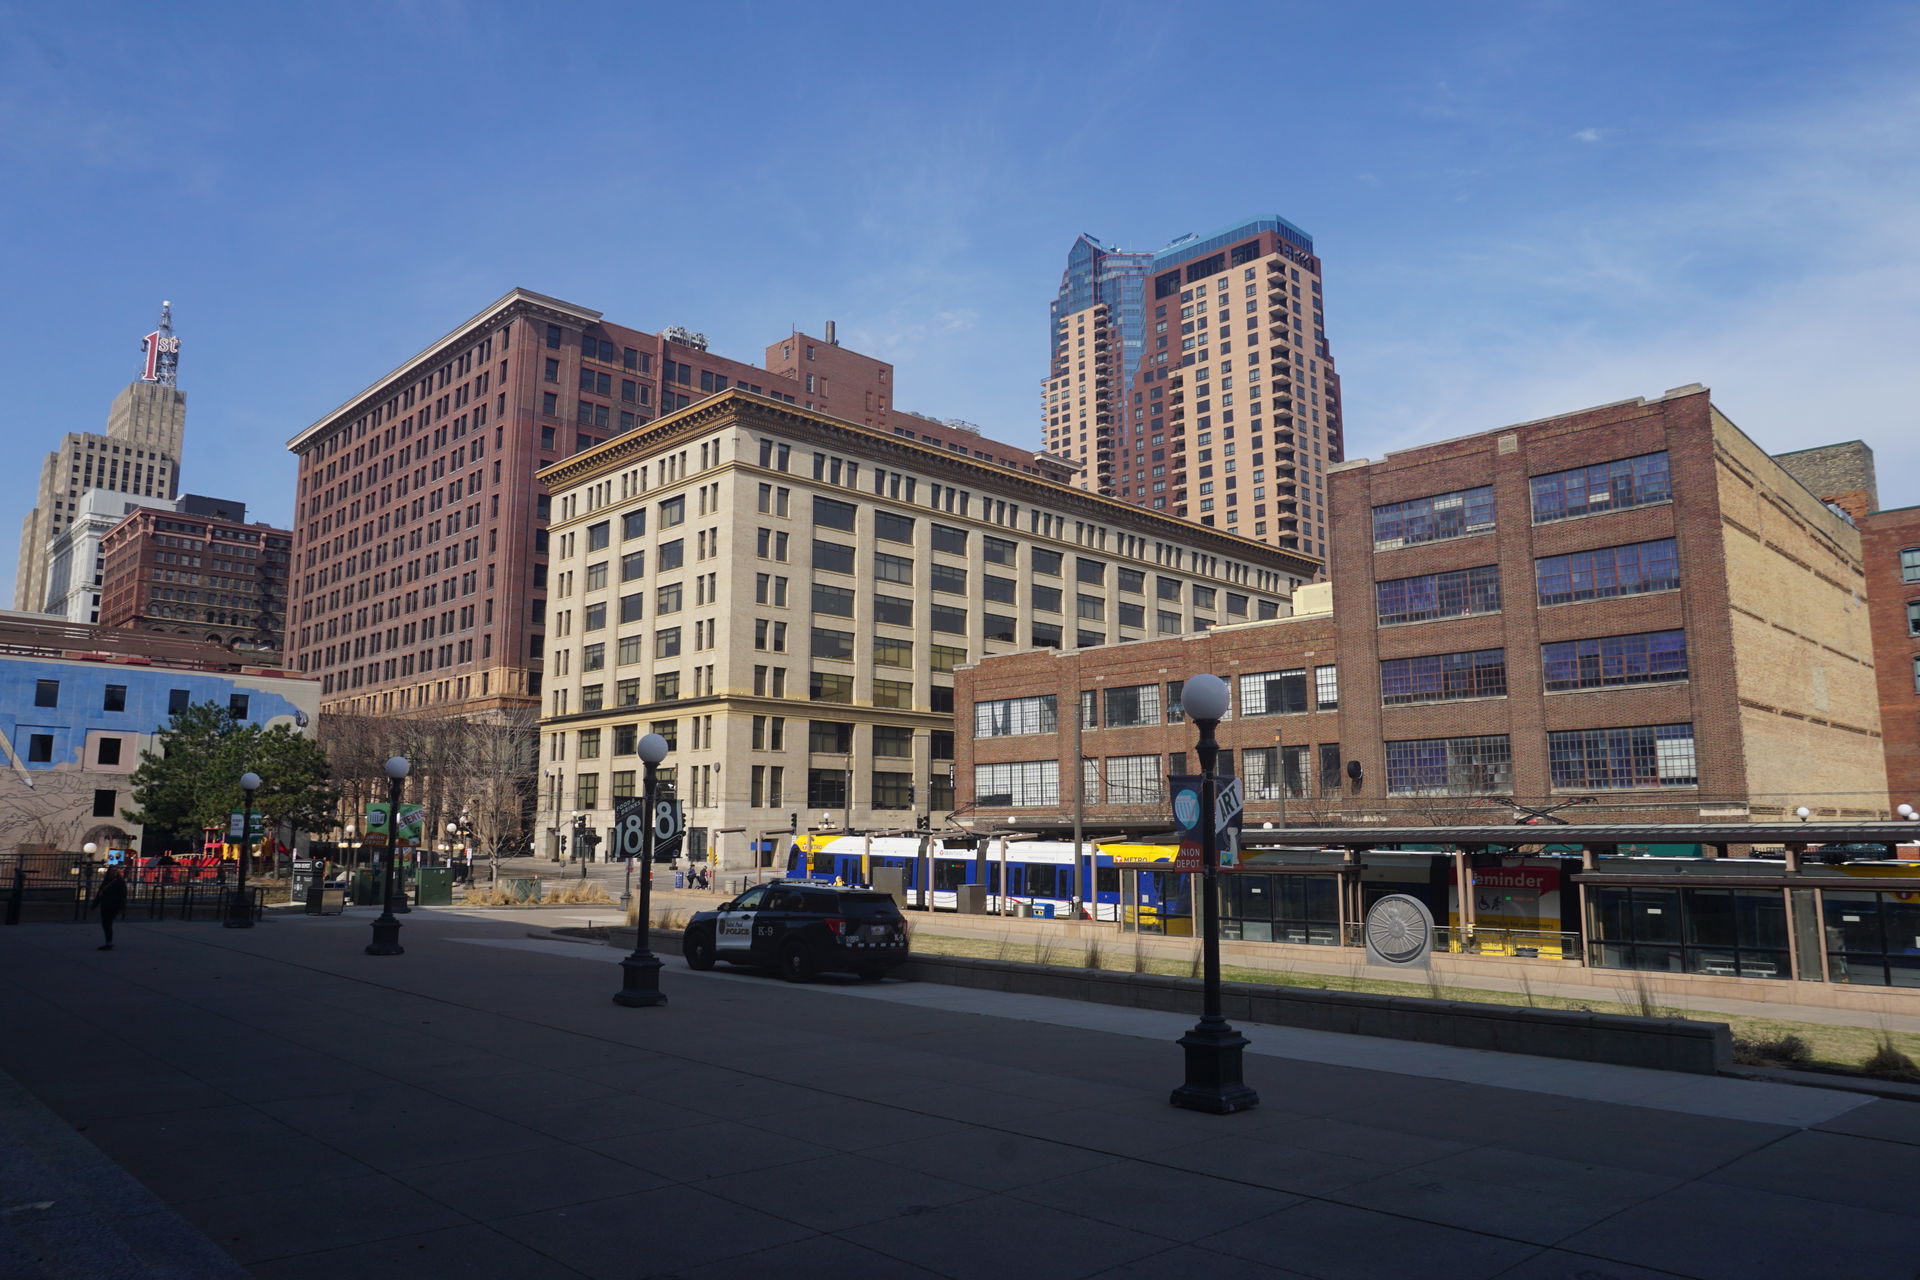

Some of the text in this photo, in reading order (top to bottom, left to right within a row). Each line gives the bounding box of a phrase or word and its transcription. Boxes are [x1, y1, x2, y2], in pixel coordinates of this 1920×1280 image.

[141, 330, 179, 381] 1st
[616, 799, 631, 812] FOOD
[1219, 784, 1240, 822] ART
[1176, 859, 1200, 869] DEPOT
[1473, 871, 1544, 888] eminder
[725, 928, 750, 936] POLICE
[758, 926, 774, 936] K-9
